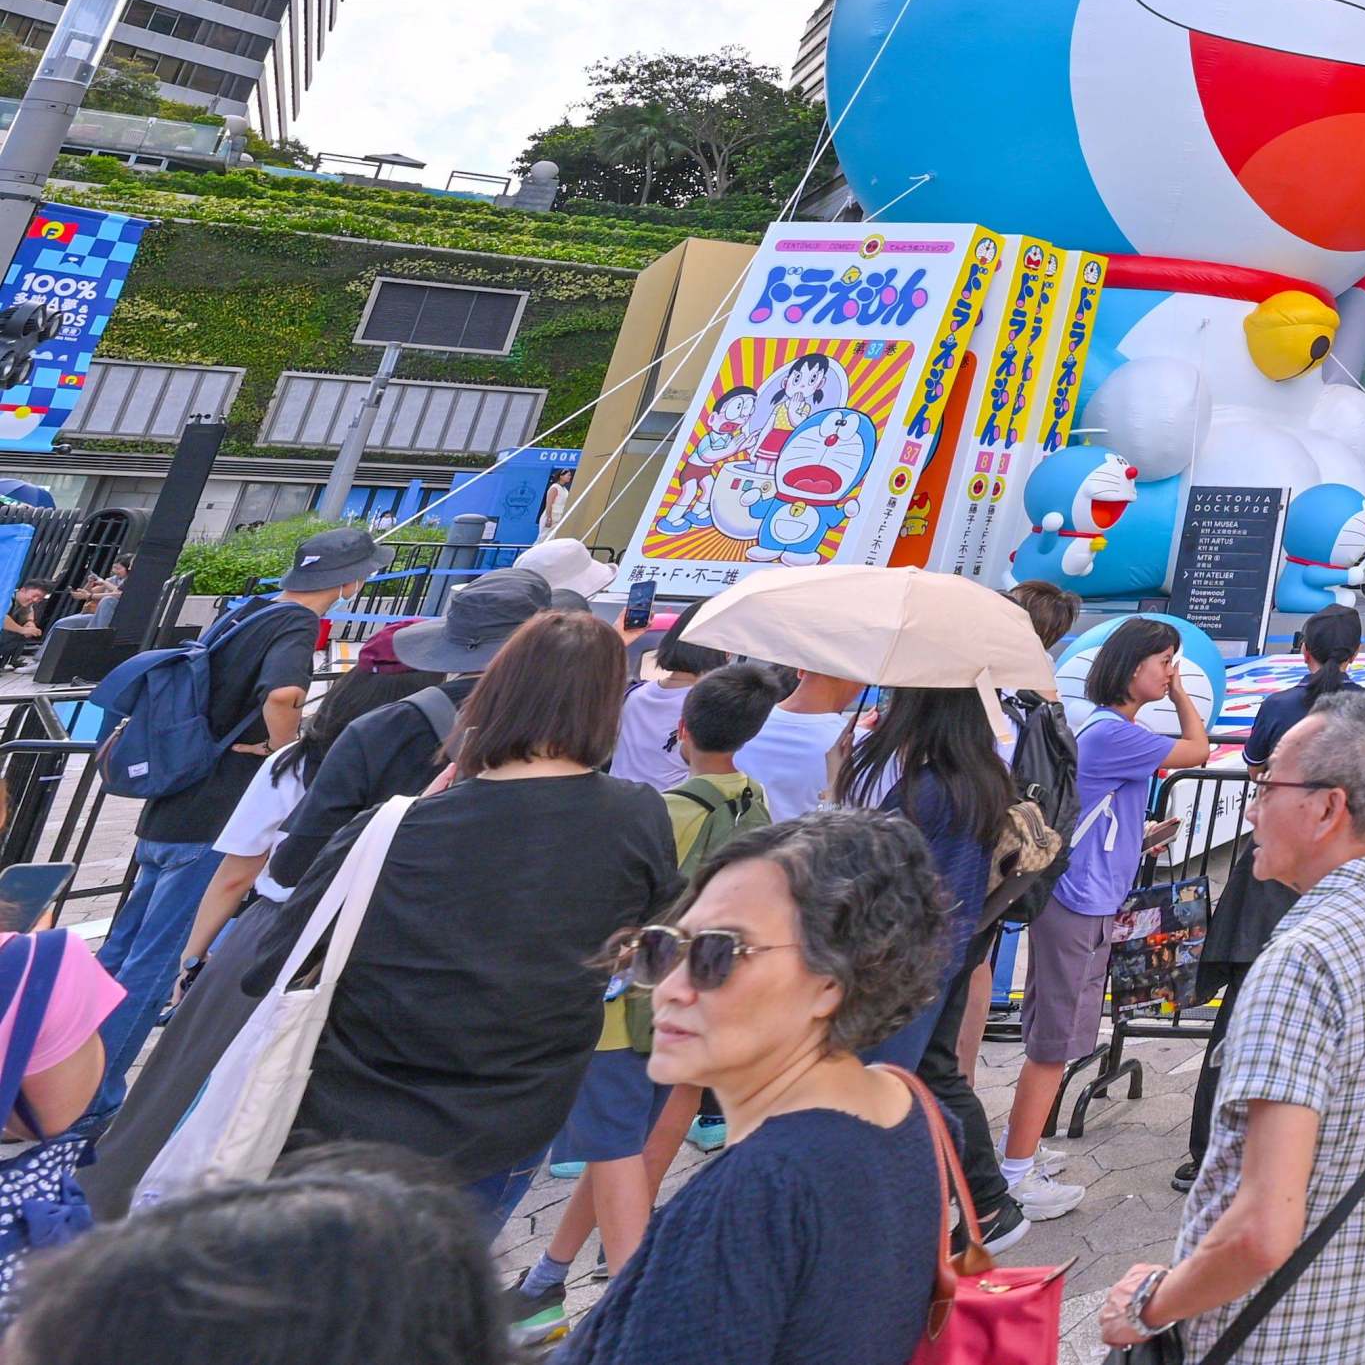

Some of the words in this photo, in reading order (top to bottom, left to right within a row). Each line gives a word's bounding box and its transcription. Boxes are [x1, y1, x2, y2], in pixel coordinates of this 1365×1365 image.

[21, 272, 98, 300] 100%
[749, 265, 928, 325] ドラえもん
[906, 263, 988, 439] ドラえもん
[980, 272, 1039, 446] ドラえもん
[1043, 286, 1096, 453] ドラえもん
[903, 443, 920, 462] 37
[1187, 613, 1221, 621] Rosewood
[1209, 597, 1226, 605] Kong
